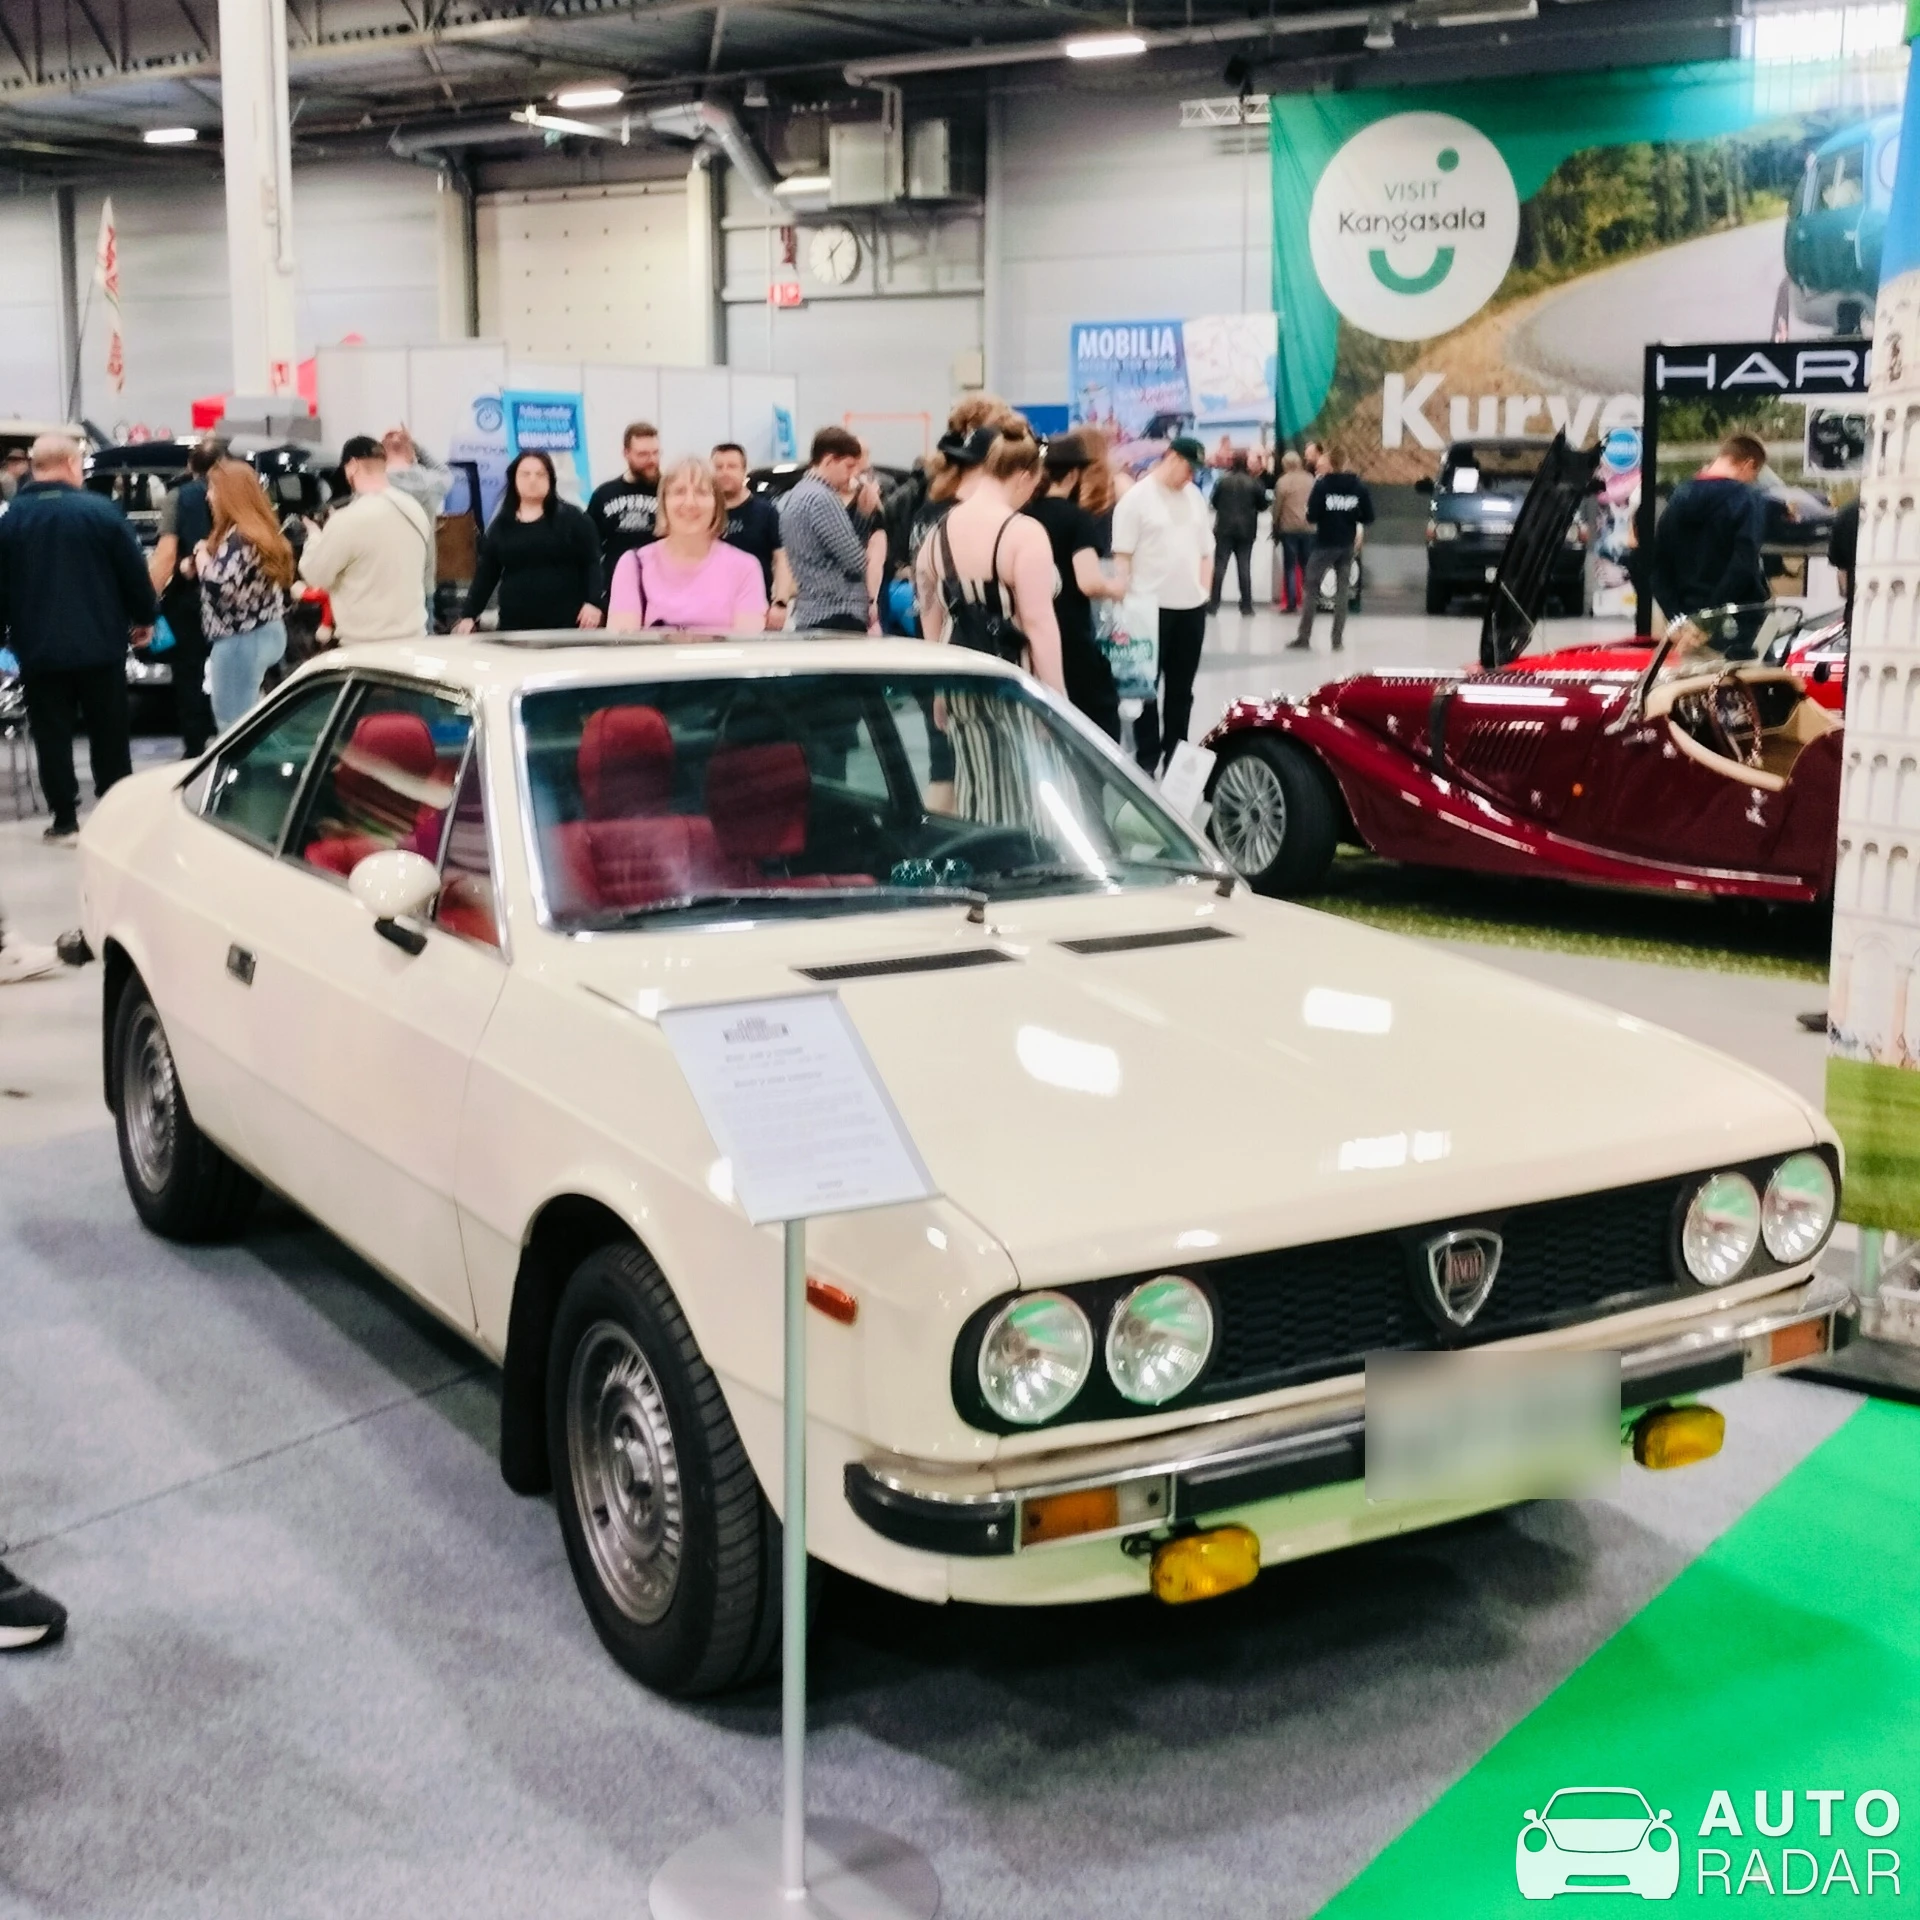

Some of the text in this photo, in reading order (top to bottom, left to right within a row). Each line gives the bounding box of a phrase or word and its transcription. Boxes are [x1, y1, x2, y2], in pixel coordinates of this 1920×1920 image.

[1384, 180, 1440, 200] VISIT
[1338, 206, 1486, 243] Kangasala
[1077, 325, 1177, 360] MOBILIA
